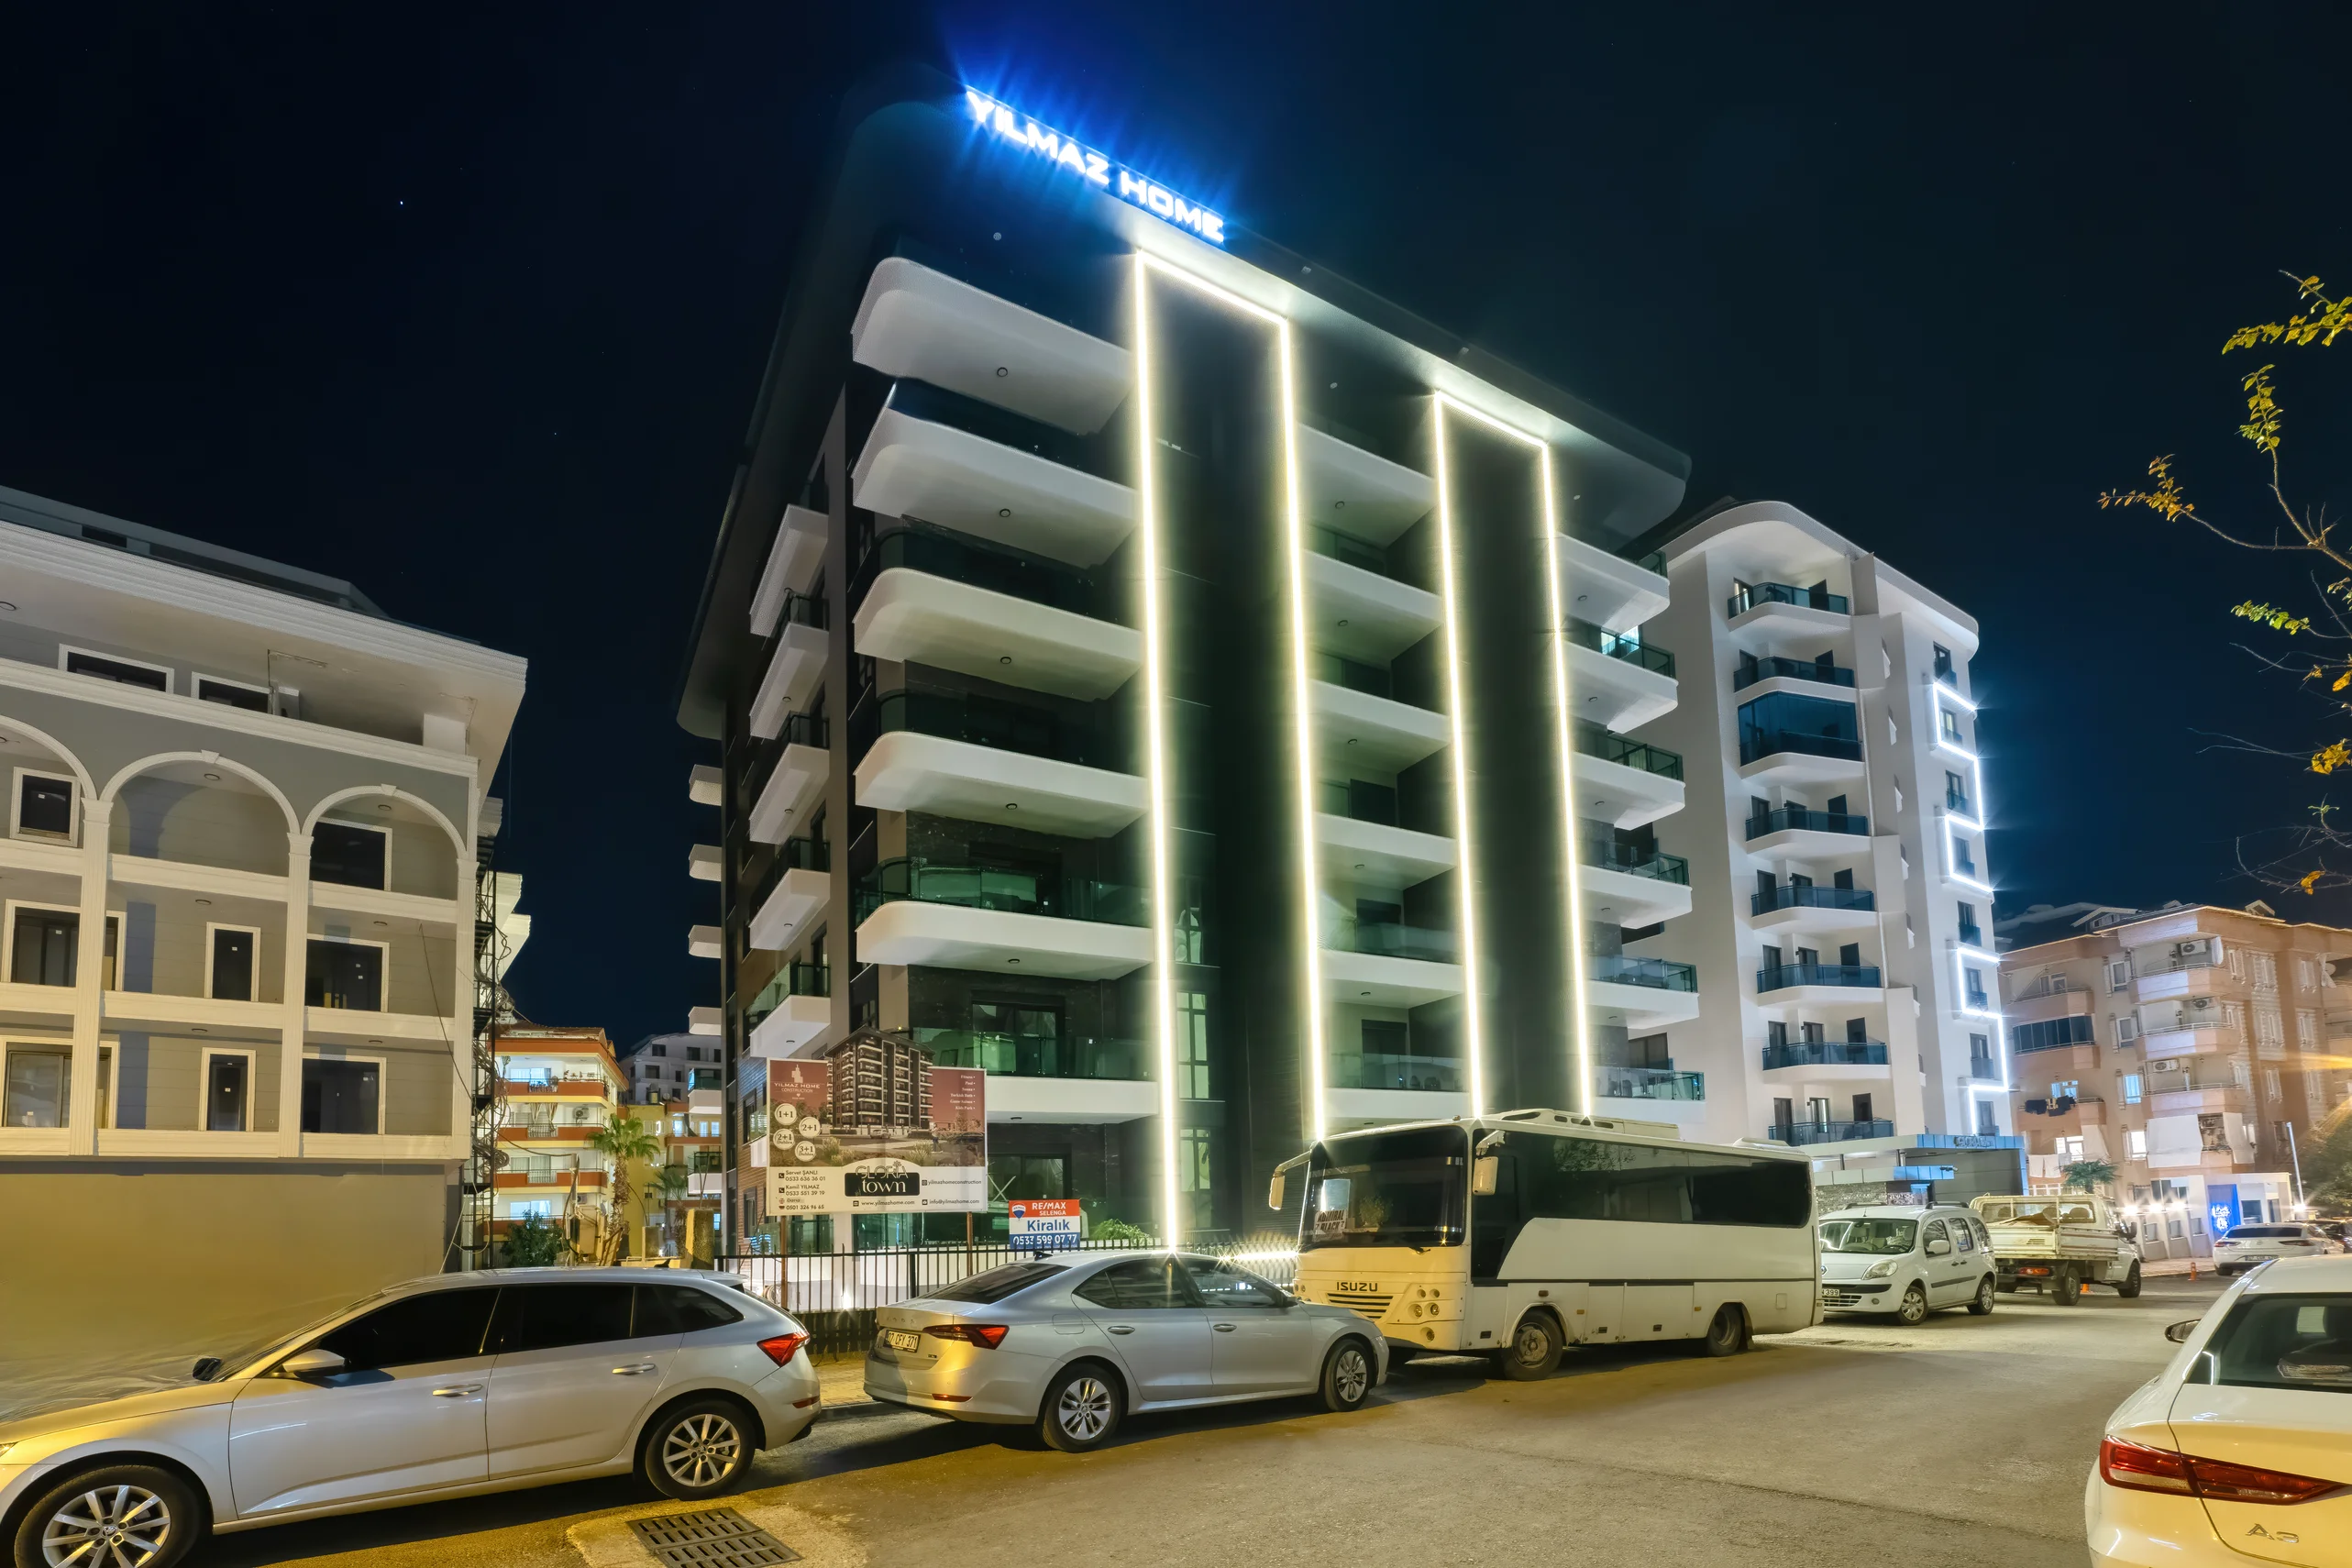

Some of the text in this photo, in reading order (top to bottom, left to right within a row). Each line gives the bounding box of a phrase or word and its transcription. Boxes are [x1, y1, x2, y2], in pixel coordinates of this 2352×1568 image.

[966, 91, 1224, 243] YILMAZ HOME
[801, 1123, 817, 1132] 2+1
[856, 1164, 909, 1179] GLORIA
[862, 1179, 906, 1193] town
[1032, 1201, 1066, 1210] RE/MAX
[1027, 1220, 1070, 1231] Kiralık
[1012, 1235, 1035, 1245] 0533
[1036, 1234, 1053, 1244] 599
[1055, 1234, 1066, 1243] 07
[1337, 1281, 1378, 1292] ISUZU
[907, 1335, 918, 1349] 371
[2245, 1522, 2300, 1544] A3
